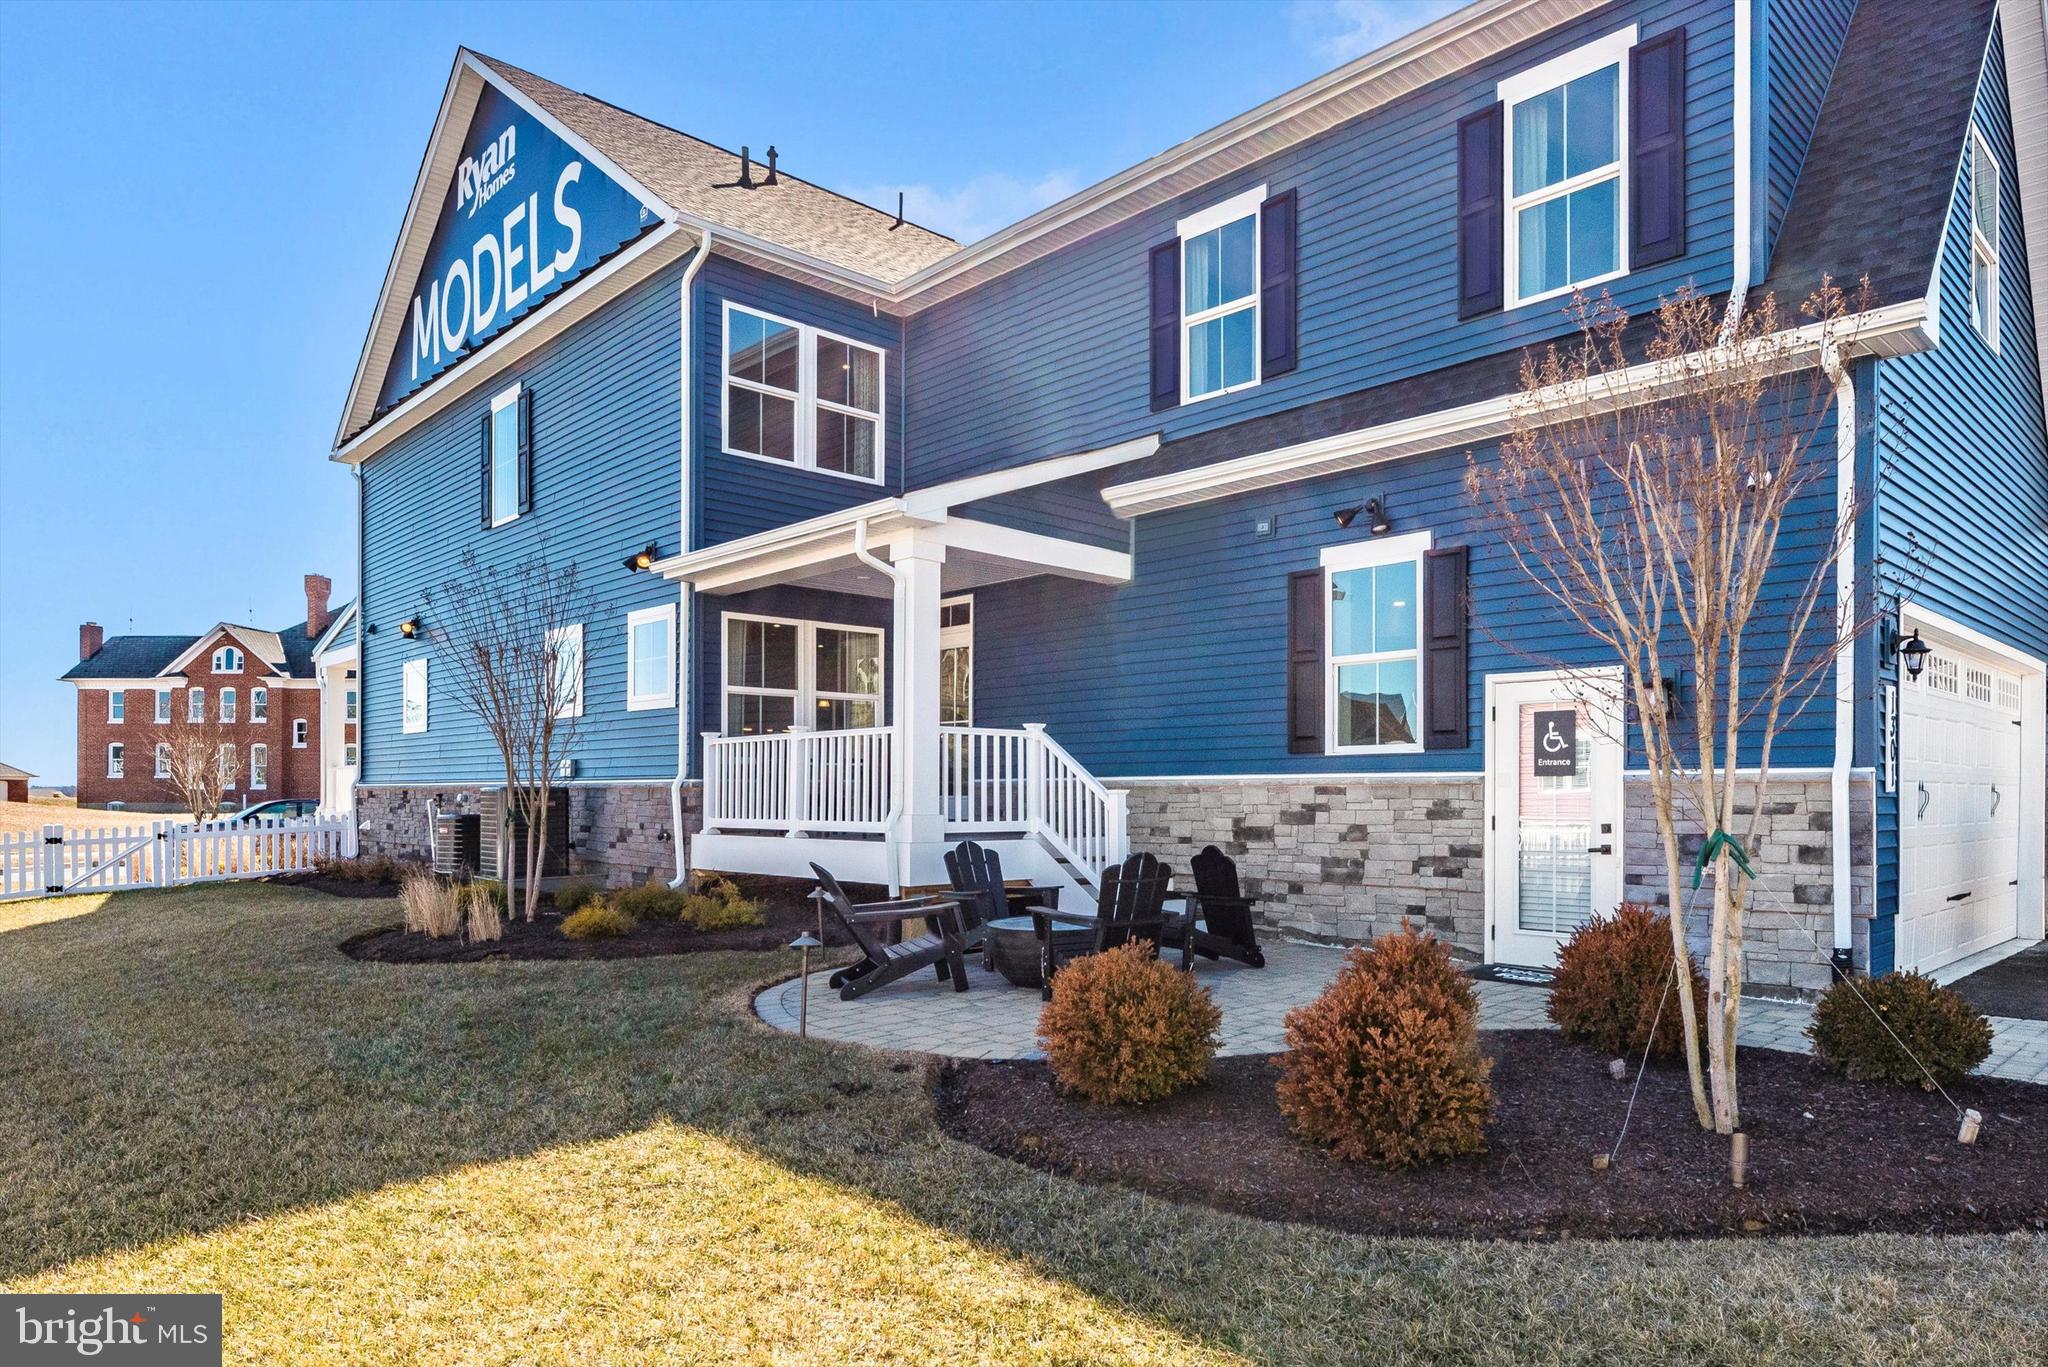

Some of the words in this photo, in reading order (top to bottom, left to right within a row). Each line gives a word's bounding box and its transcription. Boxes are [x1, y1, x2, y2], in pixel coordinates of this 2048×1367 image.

[456, 125, 516, 219] Ryan
[478, 163, 516, 210] Homes
[411, 161, 582, 381] MODELS
[1538, 758, 1571, 766] Entrance
